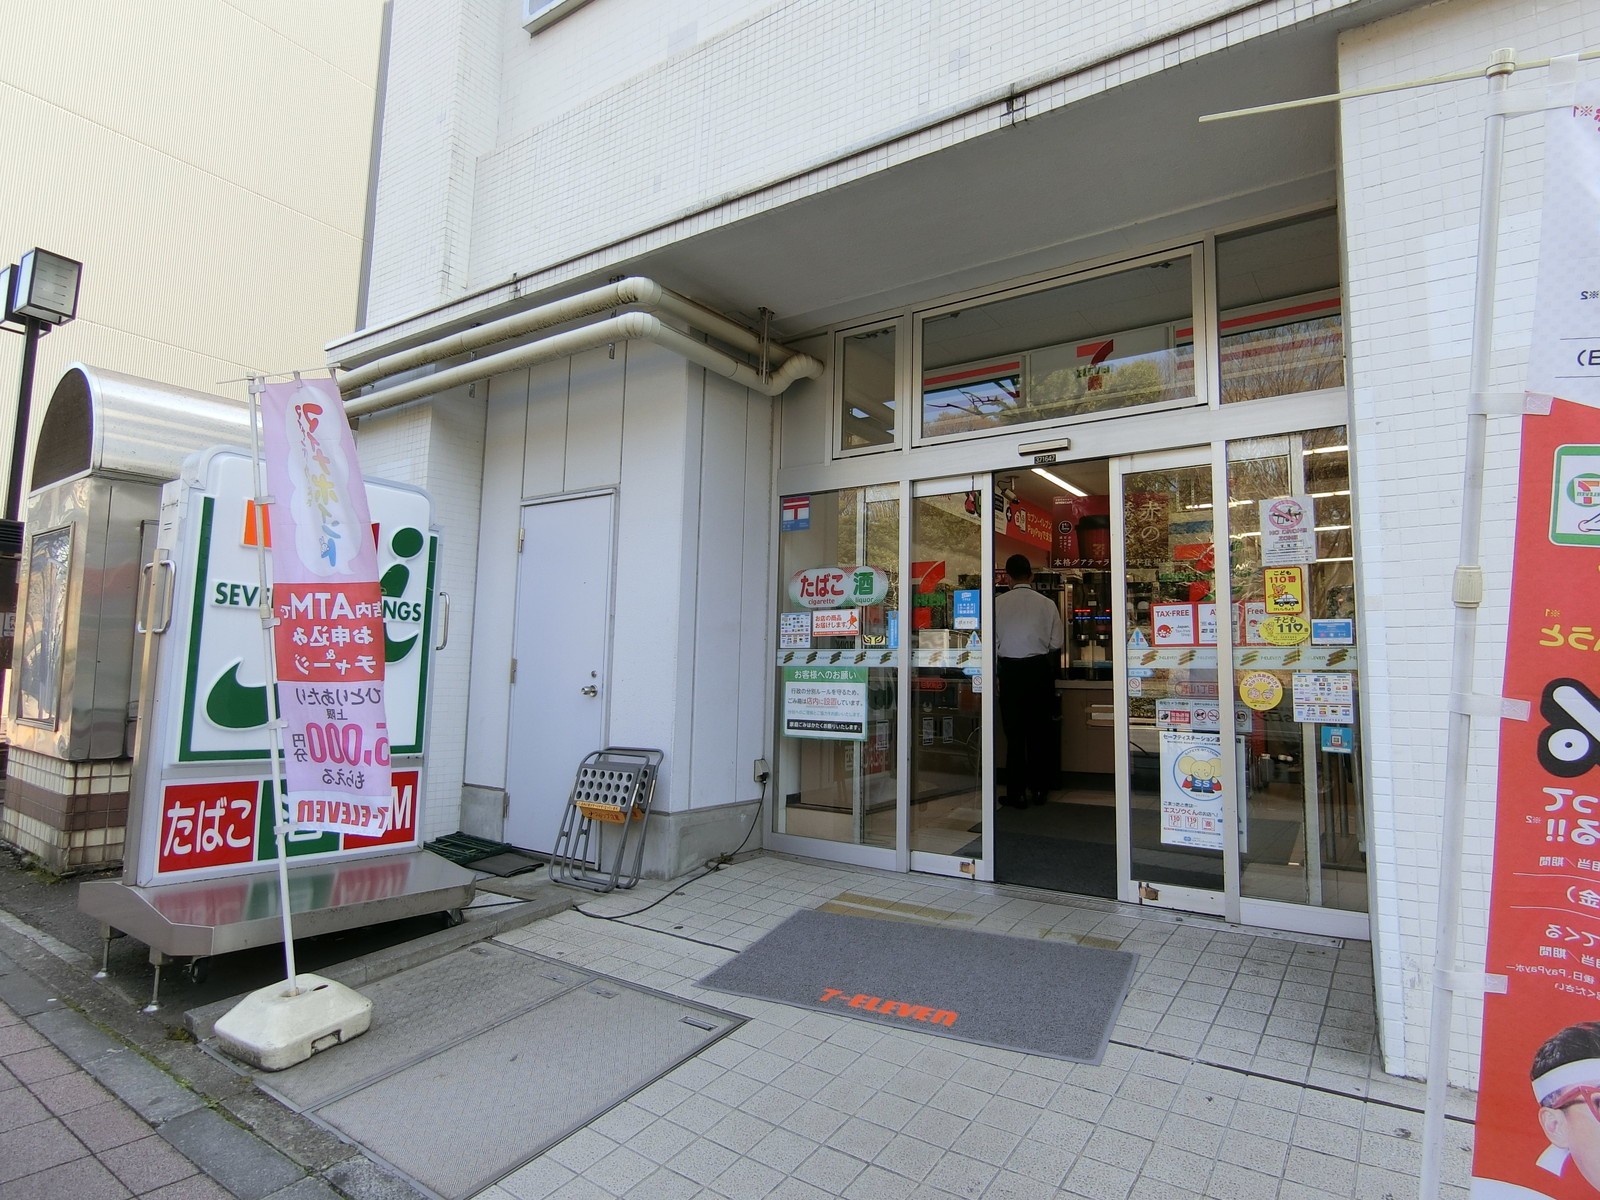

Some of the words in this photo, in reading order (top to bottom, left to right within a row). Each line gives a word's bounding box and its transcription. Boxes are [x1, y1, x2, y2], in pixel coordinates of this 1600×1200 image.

[800, 573, 844, 598] たばこ
[853, 571, 874, 596] 酒
[808, 598, 835, 606] cigarette
[1274, 616, 1296, 624] 子ども
[794, 670, 857, 680] お客様へのお願い
[1194, 779, 1210, 787] SS
[163, 796, 252, 857] たばこ
